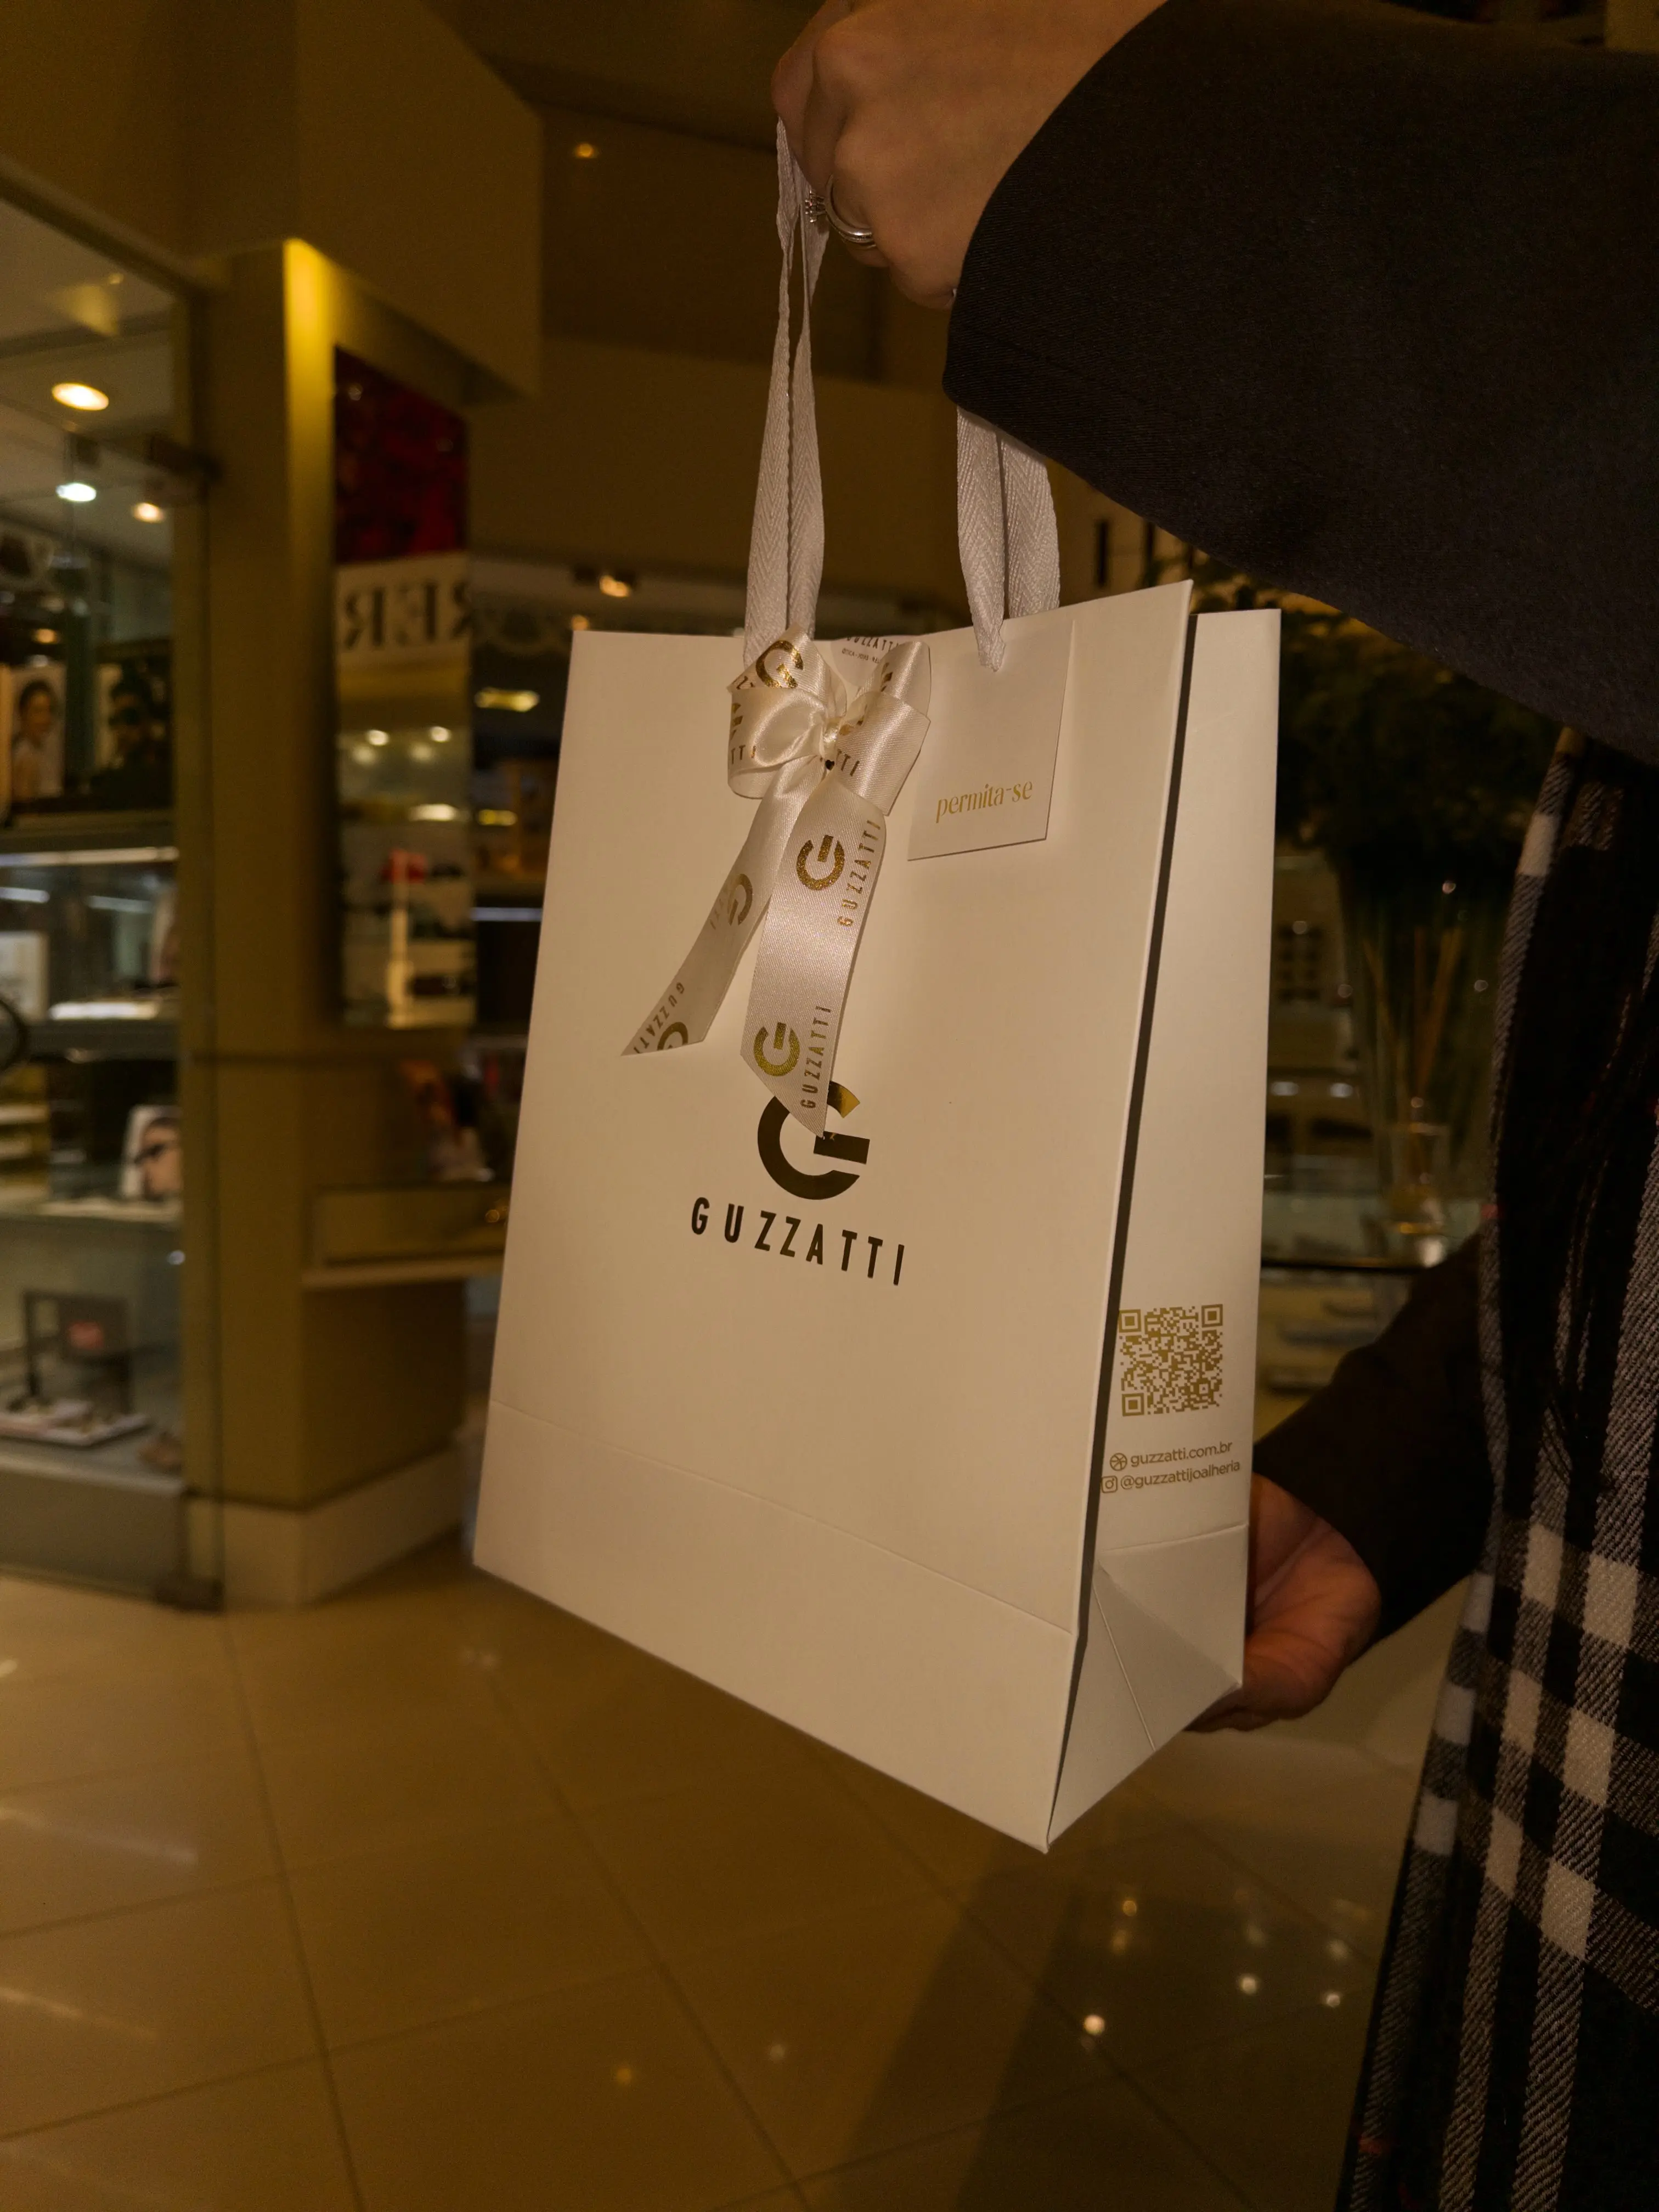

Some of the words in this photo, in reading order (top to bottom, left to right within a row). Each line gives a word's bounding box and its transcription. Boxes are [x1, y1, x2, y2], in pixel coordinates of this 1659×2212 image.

[936, 781, 1032, 823] permita-se
[837, 820, 881, 927] GUZZATTI
[800, 1006, 832, 1110] GUZZATTI
[691, 1197, 905, 1285] GUZZATTI
[1121, 1460, 1240, 1491] @guzzattijoalheria
[1130, 1441, 1233, 1468] guzzatti.com.br
